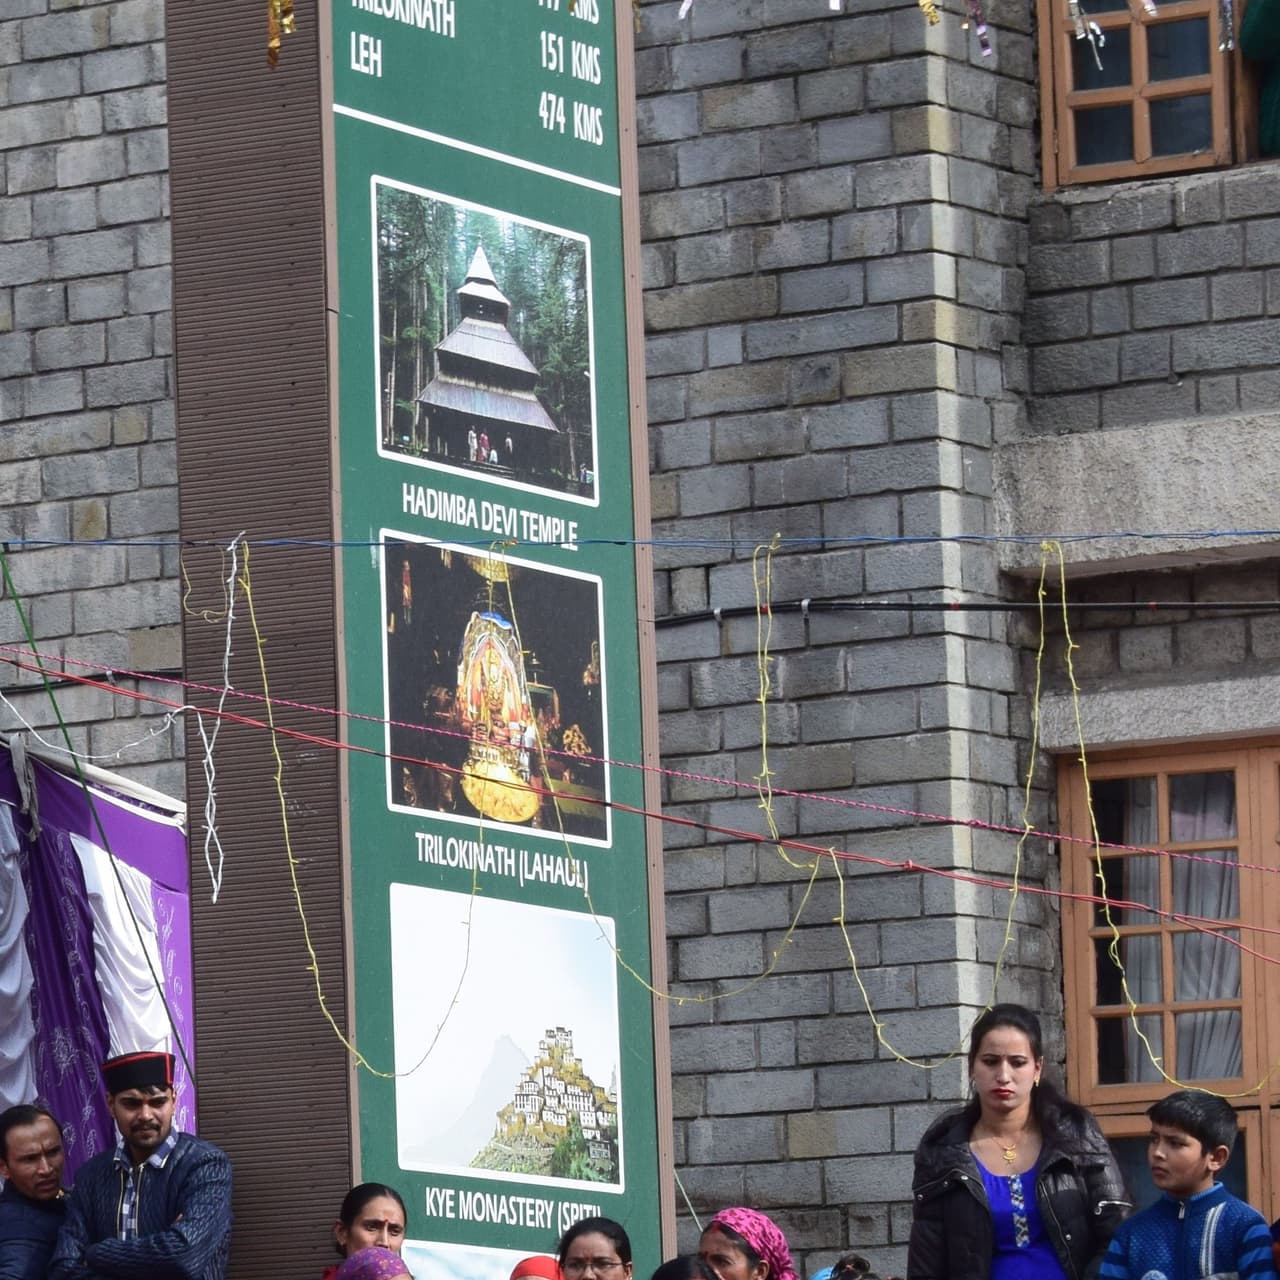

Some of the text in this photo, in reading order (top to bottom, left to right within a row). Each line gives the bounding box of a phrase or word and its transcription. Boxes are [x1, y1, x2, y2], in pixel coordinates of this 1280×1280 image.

[350, 30, 601, 85] LEH 151 KMS
[539, 91, 603, 146] 474 KMS
[402, 483, 578, 552] HADIMBA DEVI TEMPLE
[415, 831, 589, 898] TRILOKINATH (LAHAUL)
[426, 1187, 455, 1219] KYE
[459, 1190, 554, 1229] MONASTERY
